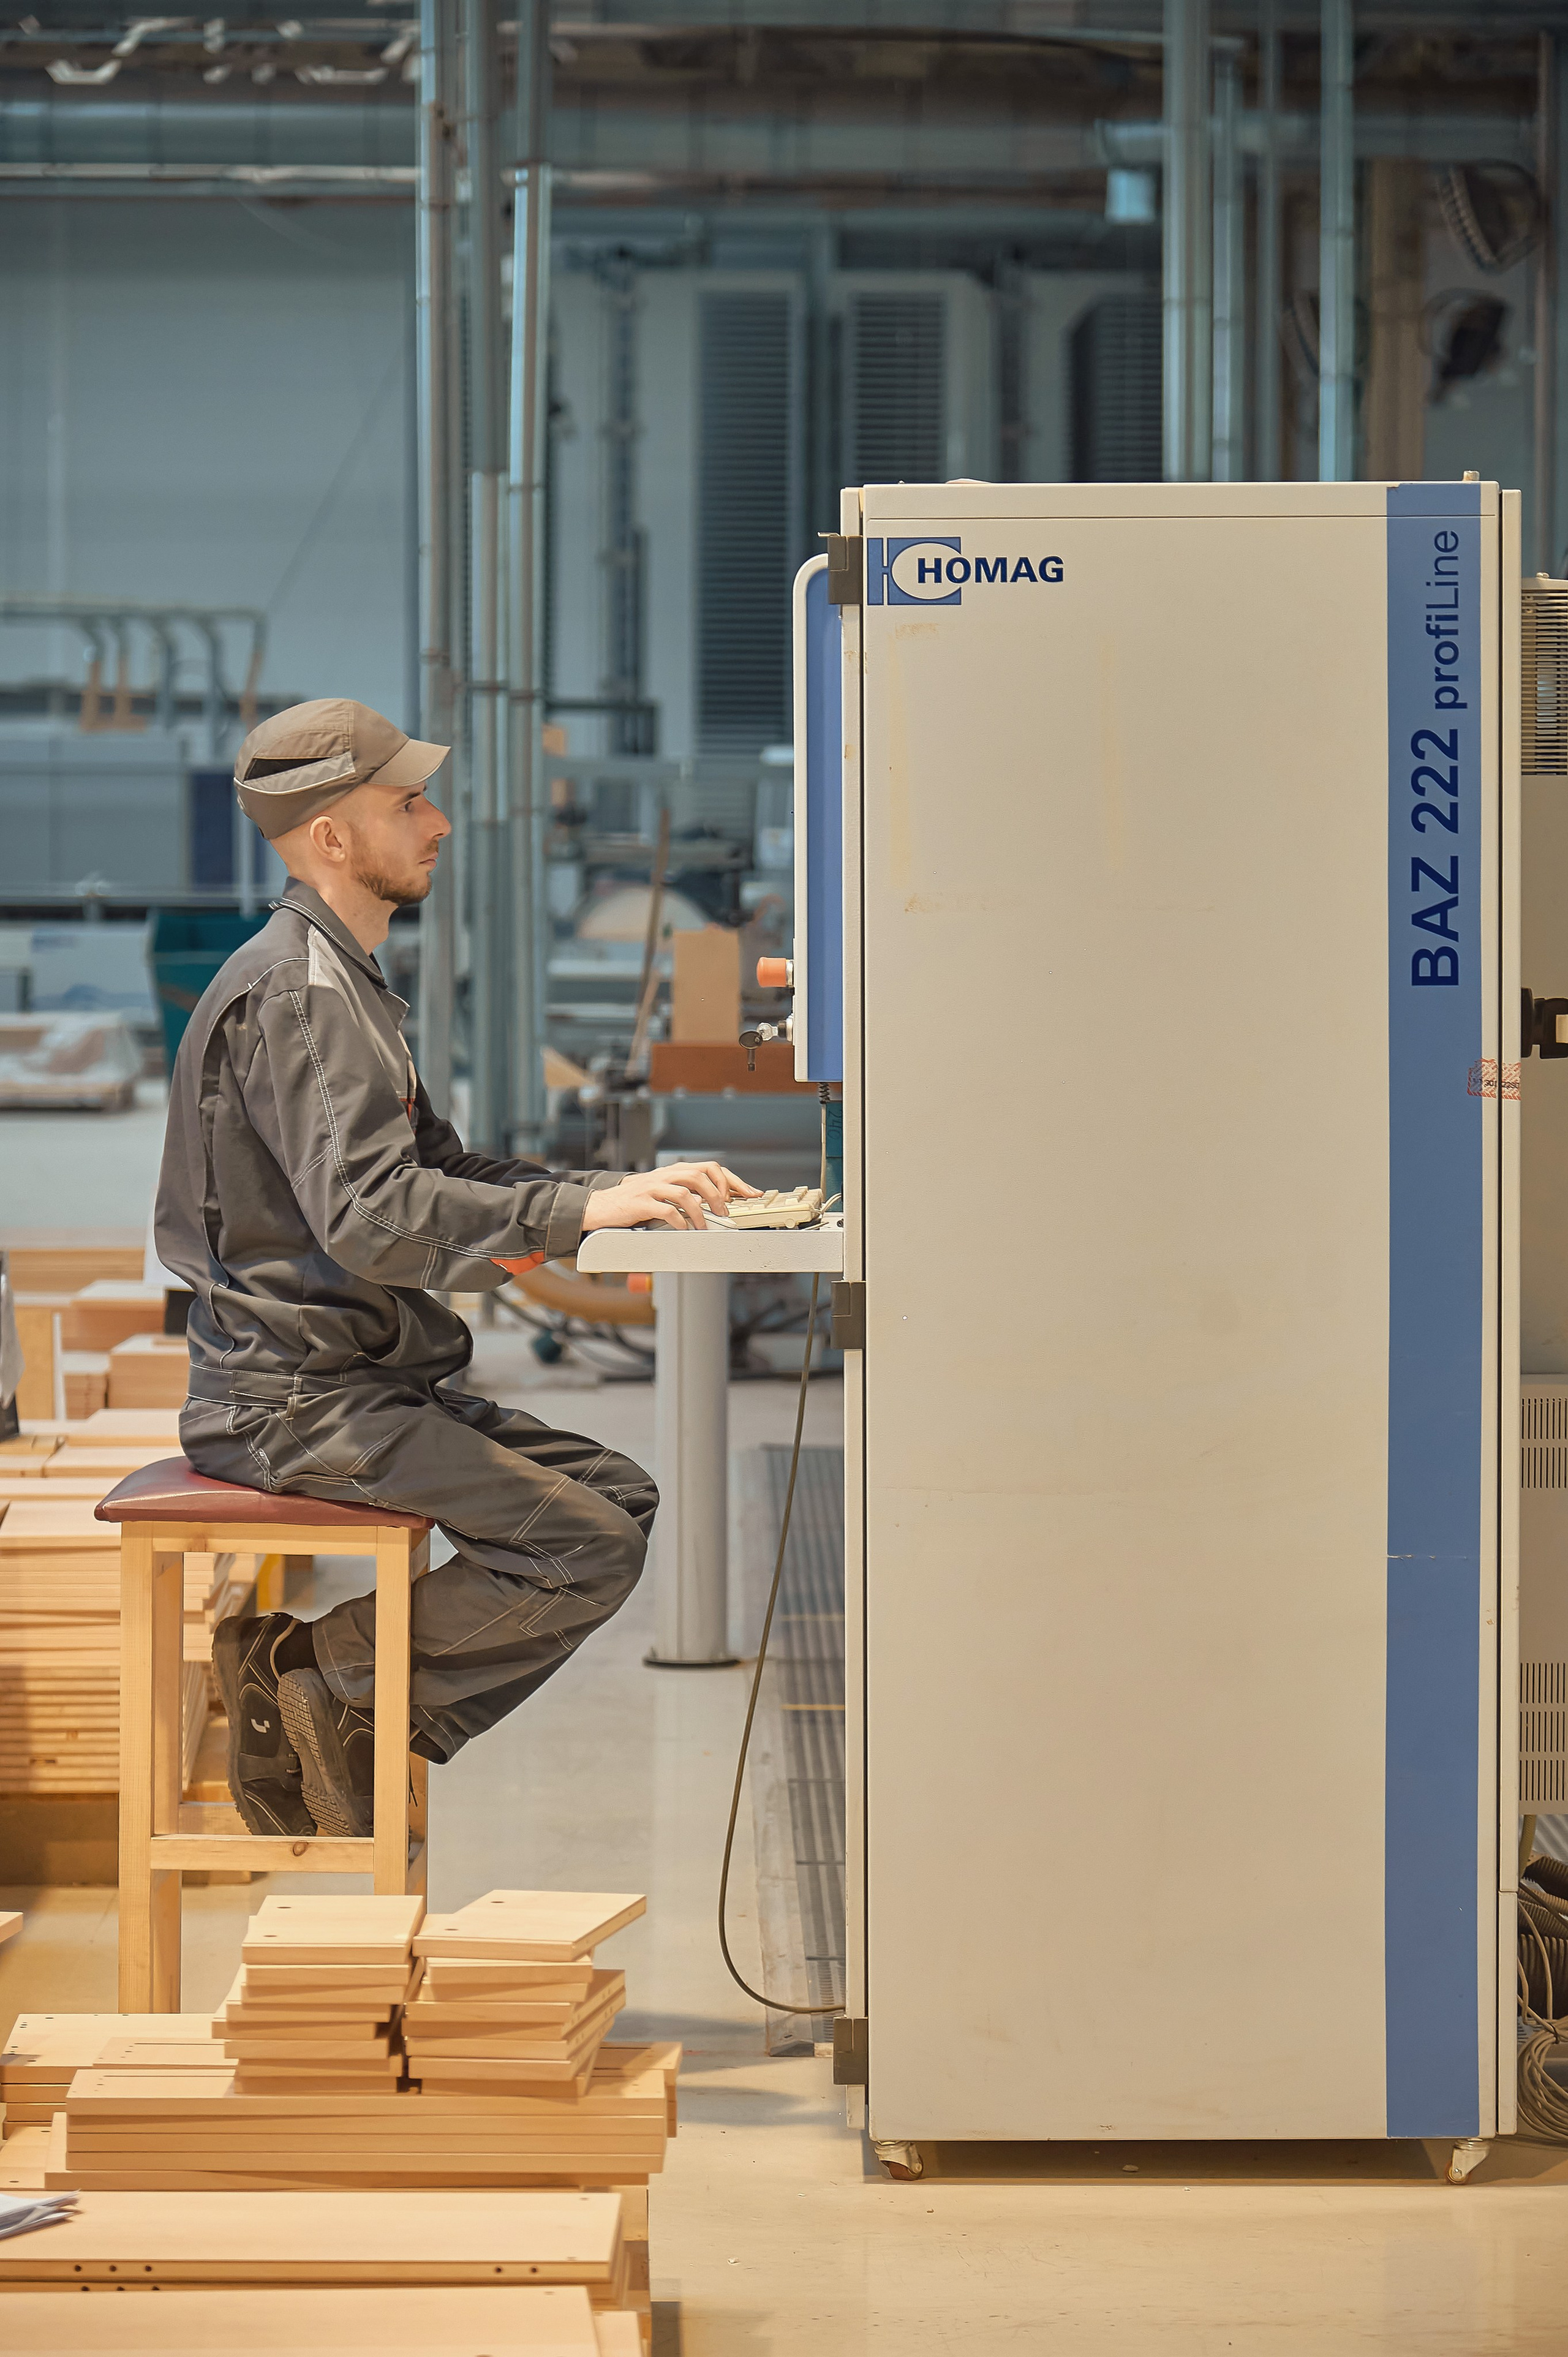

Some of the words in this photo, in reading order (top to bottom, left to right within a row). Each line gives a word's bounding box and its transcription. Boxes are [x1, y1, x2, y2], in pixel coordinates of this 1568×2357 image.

[918, 556, 1064, 584] HOMAG
[1426, 531, 1468, 710] profiLine
[1411, 728, 1459, 834] 222
[1411, 855, 1459, 987] BAZ
